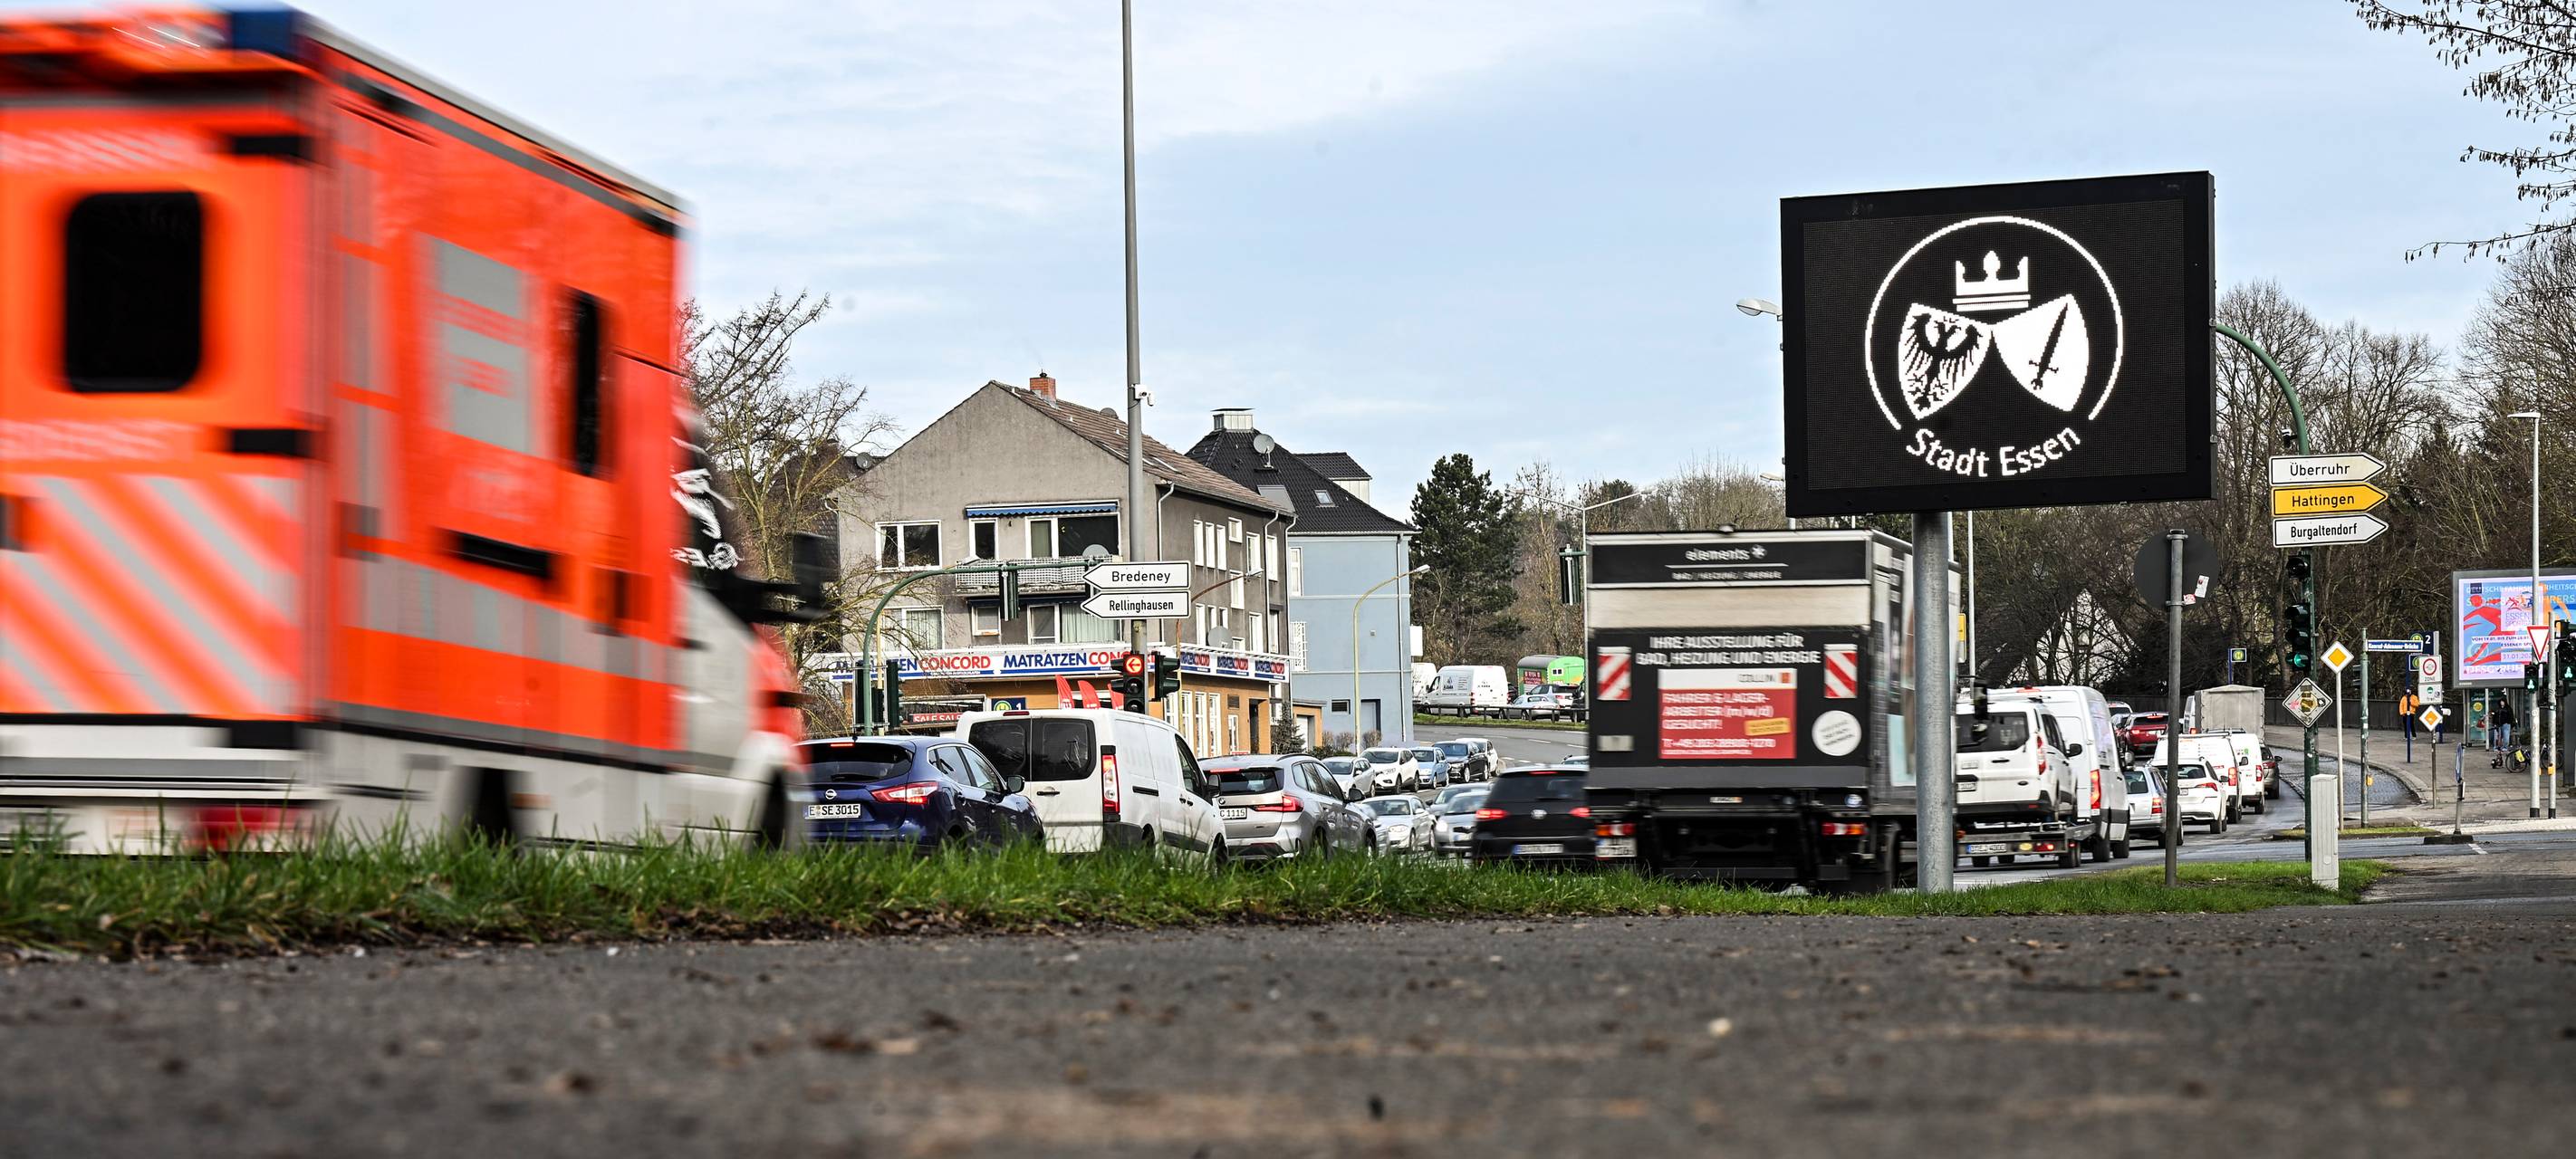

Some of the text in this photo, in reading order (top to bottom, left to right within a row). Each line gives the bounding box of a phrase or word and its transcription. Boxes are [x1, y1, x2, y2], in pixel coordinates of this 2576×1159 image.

[1906, 427, 2081, 477] Stadt Essen
[2290, 462, 2350, 476] Überruhr
[2292, 494, 2355, 508] Hattingen
[2291, 523, 2358, 540] Burgaltendorf
[1685, 548, 1751, 561] elements
[1111, 570, 1171, 584] Bredeney
[1109, 599, 1174, 613] Rellinghausen
[1649, 632, 1804, 649] IHRE AUSSTELLUNG FÜR
[2425, 635, 2431, 644] 2
[918, 655, 991, 671] CONCORD
[1004, 652, 1087, 668] MATRATZEN
[1730, 652, 1764, 665] UND
[1764, 650, 1821, 664] ENERGIE
[1015, 703, 1023, 711] 1
[809, 804, 860, 816] E SE 3015
[1226, 809, 1245, 818] 1115
